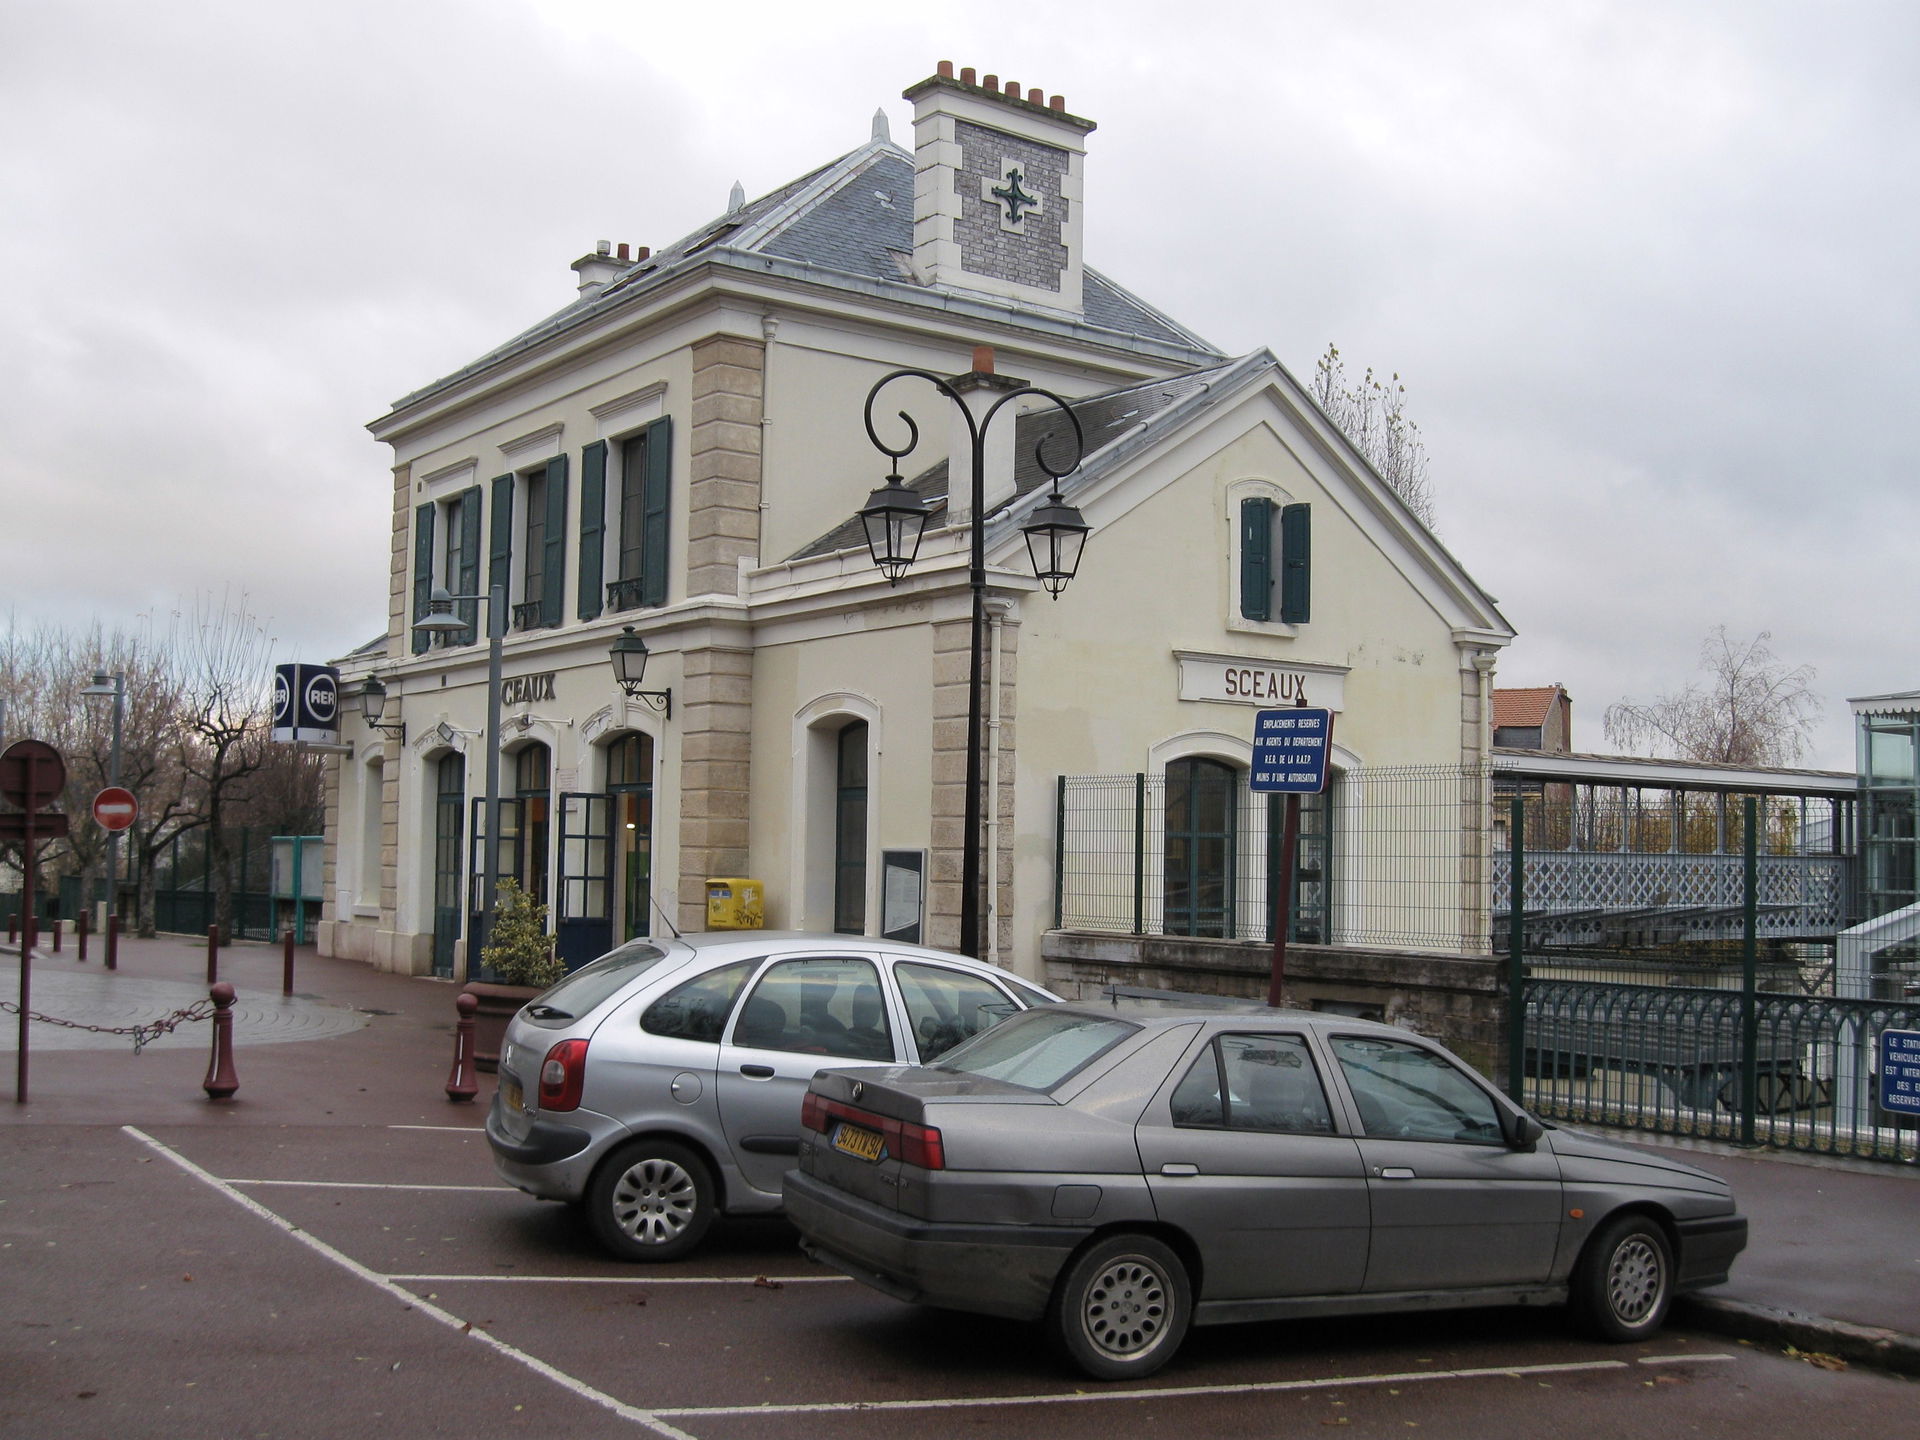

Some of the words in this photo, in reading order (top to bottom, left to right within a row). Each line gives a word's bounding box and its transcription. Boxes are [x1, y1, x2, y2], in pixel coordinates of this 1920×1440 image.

[501, 672, 556, 706] CEAUX
[1225, 668, 1305, 700] SCEAUX
[275, 689, 286, 704] ER
[310, 689, 335, 705] RER
[1263, 719, 1295, 729] EMPLACEMENTS
[1255, 737, 1263, 747] AUX
[1265, 737, 1281, 747] AGENTS
[1284, 737, 1290, 747] DU
[1292, 737, 1323, 747] DEPARTEMENT
[1279, 754, 1285, 764] DE
[1287, 755, 1293, 764] LA
[1889, 1037, 1897, 1047] LE
[1885, 1065, 1897, 1075] EST
[1896, 1080, 1910, 1091] DES
[1888, 1093, 1920, 1106] RESERVES
